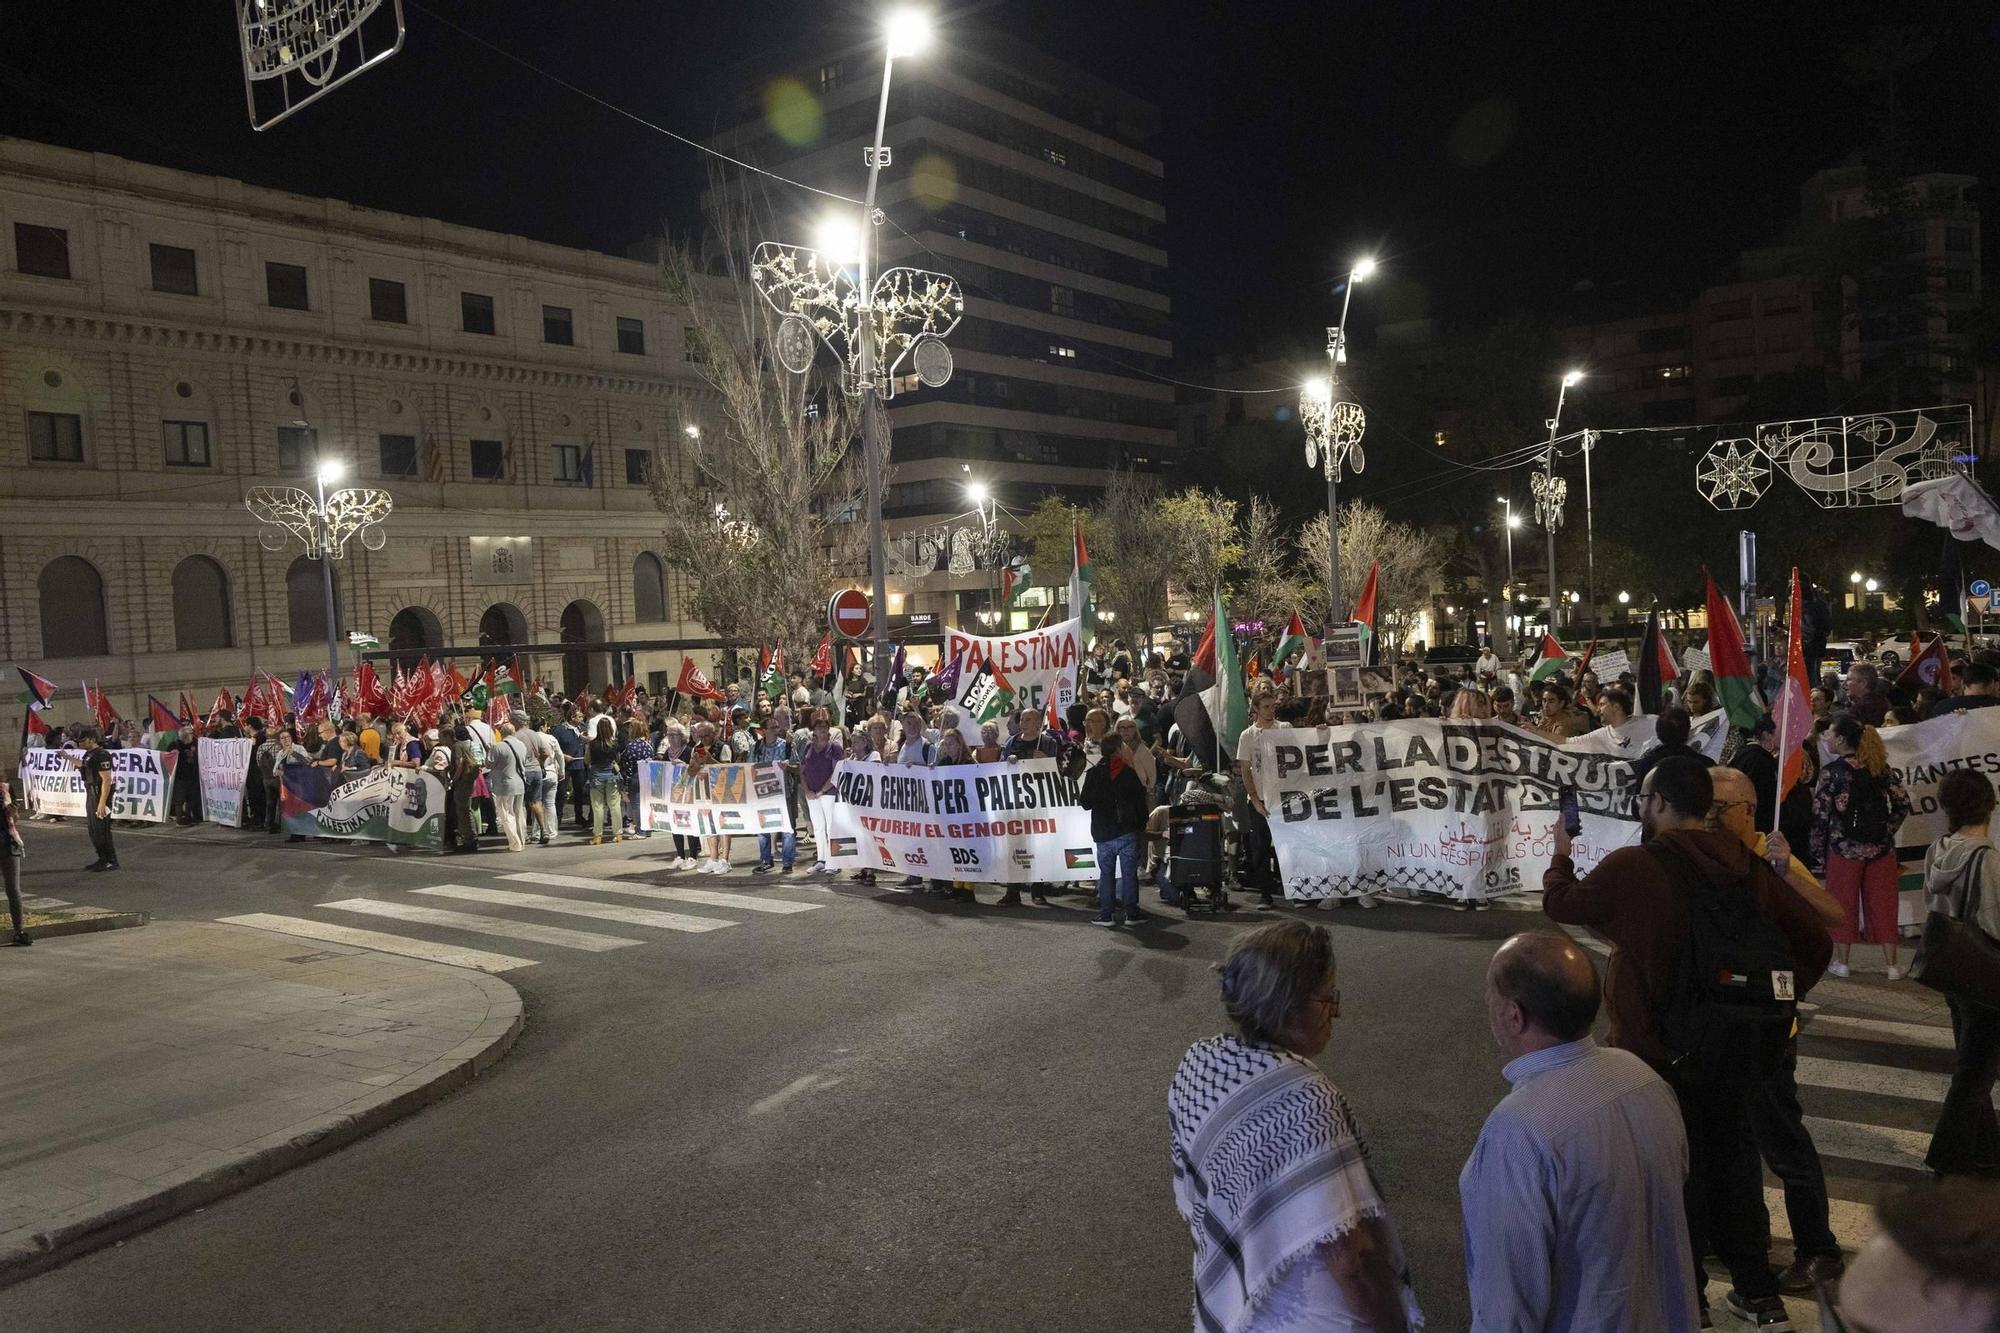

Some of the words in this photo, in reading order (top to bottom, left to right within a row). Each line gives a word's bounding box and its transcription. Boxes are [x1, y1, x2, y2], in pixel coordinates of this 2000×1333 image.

[1275, 740, 1364, 778] PER
[1373, 735, 1440, 771] LA
[835, 771, 874, 808] VAGA
[880, 775, 930, 814] GENERAL
[931, 778, 969, 815] PER
[975, 771, 1081, 812] PALESTINA
[1280, 787, 1342, 823] DE
[1351, 776, 1519, 818] L'ESTAT
[316, 809, 367, 833] PALESTINA
[365, 803, 390, 819] LIBRE
[860, 815, 921, 837] ATUREM
[924, 823, 945, 838] EL
[947, 818, 1057, 839] GENOCIDI
[949, 847, 980, 865] BDS
[1387, 843, 1404, 859] NI
[1410, 842, 1436, 858] UN
